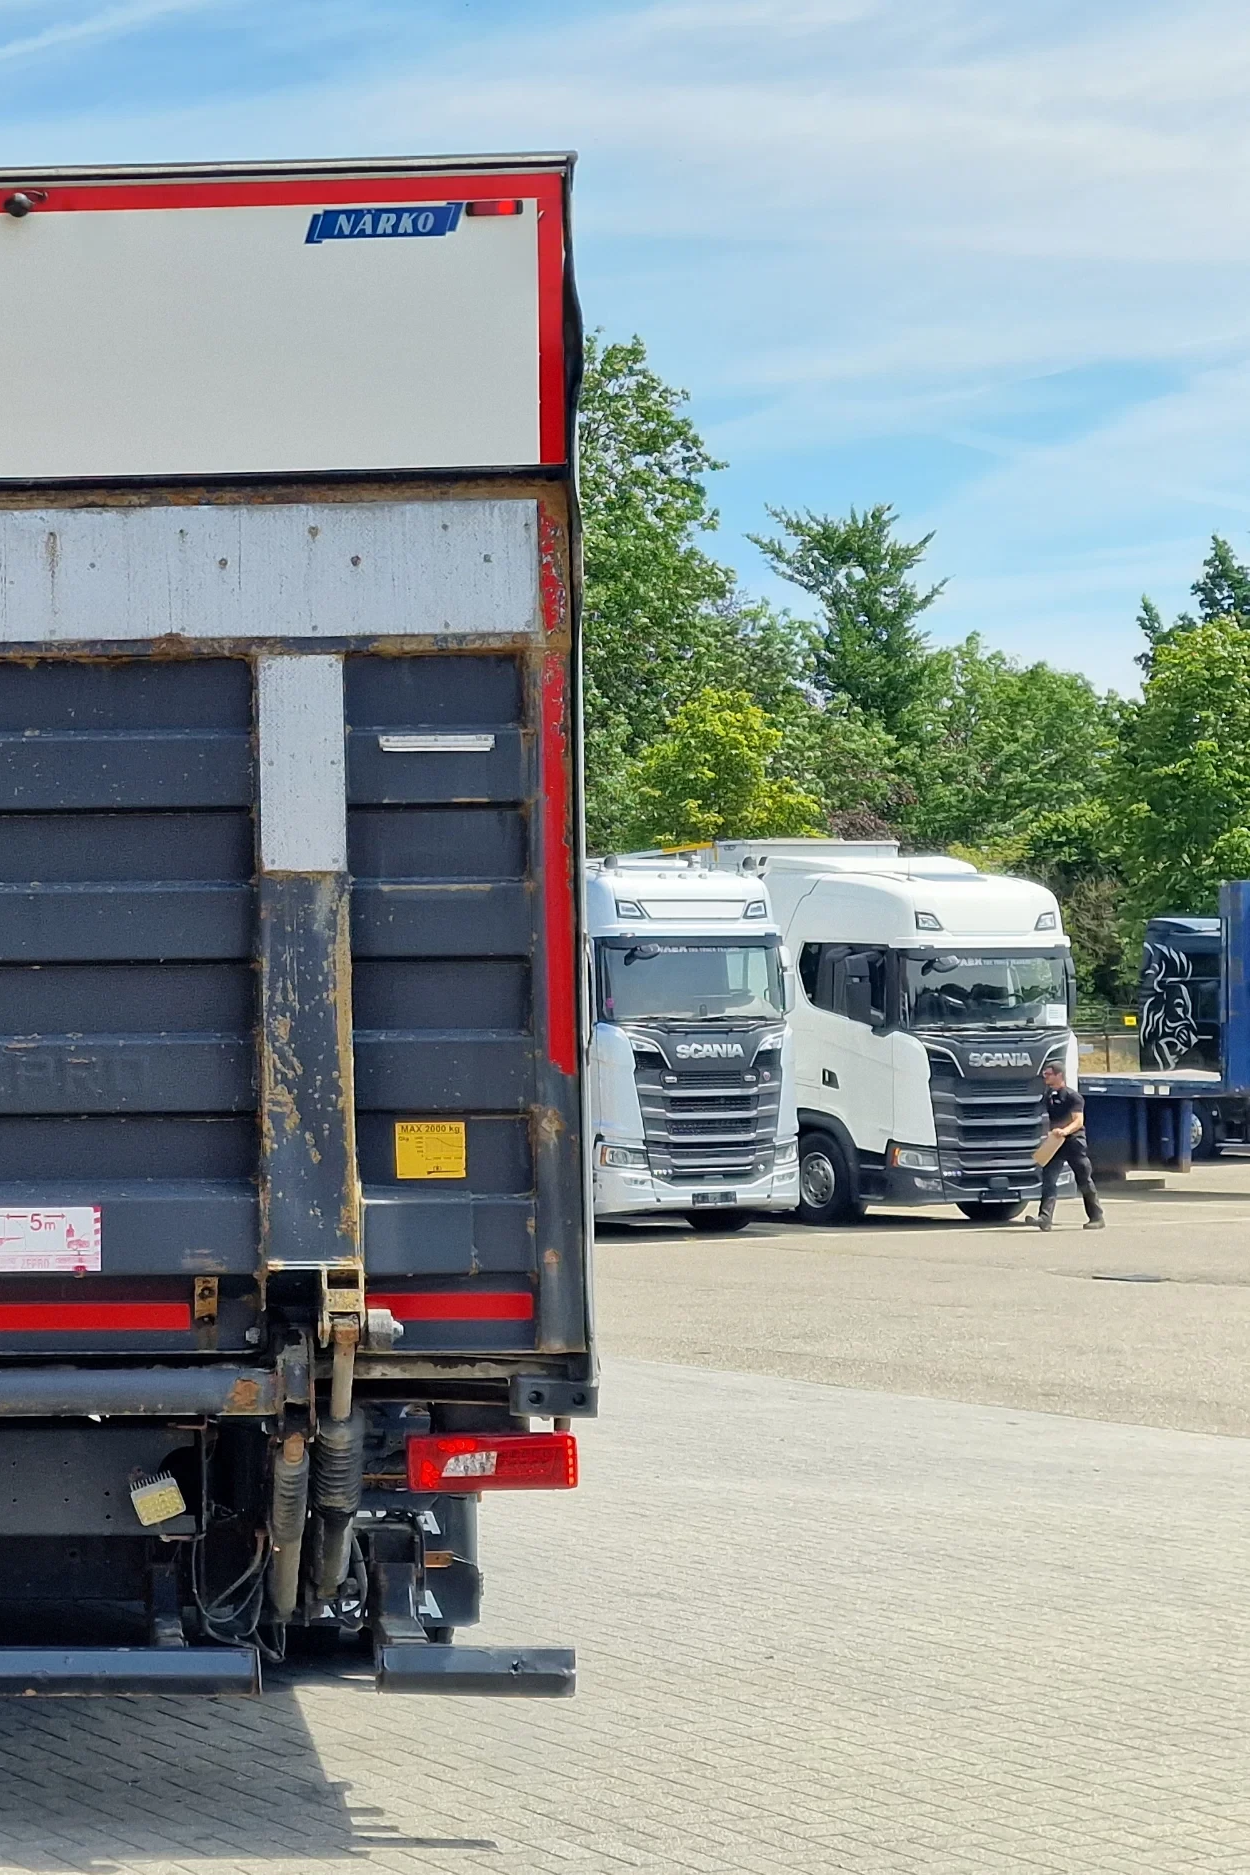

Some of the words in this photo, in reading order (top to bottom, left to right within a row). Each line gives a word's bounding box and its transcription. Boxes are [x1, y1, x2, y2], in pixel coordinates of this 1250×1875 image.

[334, 208, 434, 236] NÄRKO
[676, 1042, 745, 1059] SCANIA
[968, 1052, 1033, 1067] SCANIA
[401, 1125, 422, 1133] MAX
[425, 1124, 447, 1133] 2000
[449, 1124, 460, 1134] kg
[30, 1213, 42, 1231] 5
[44, 1221, 56, 1230] m
